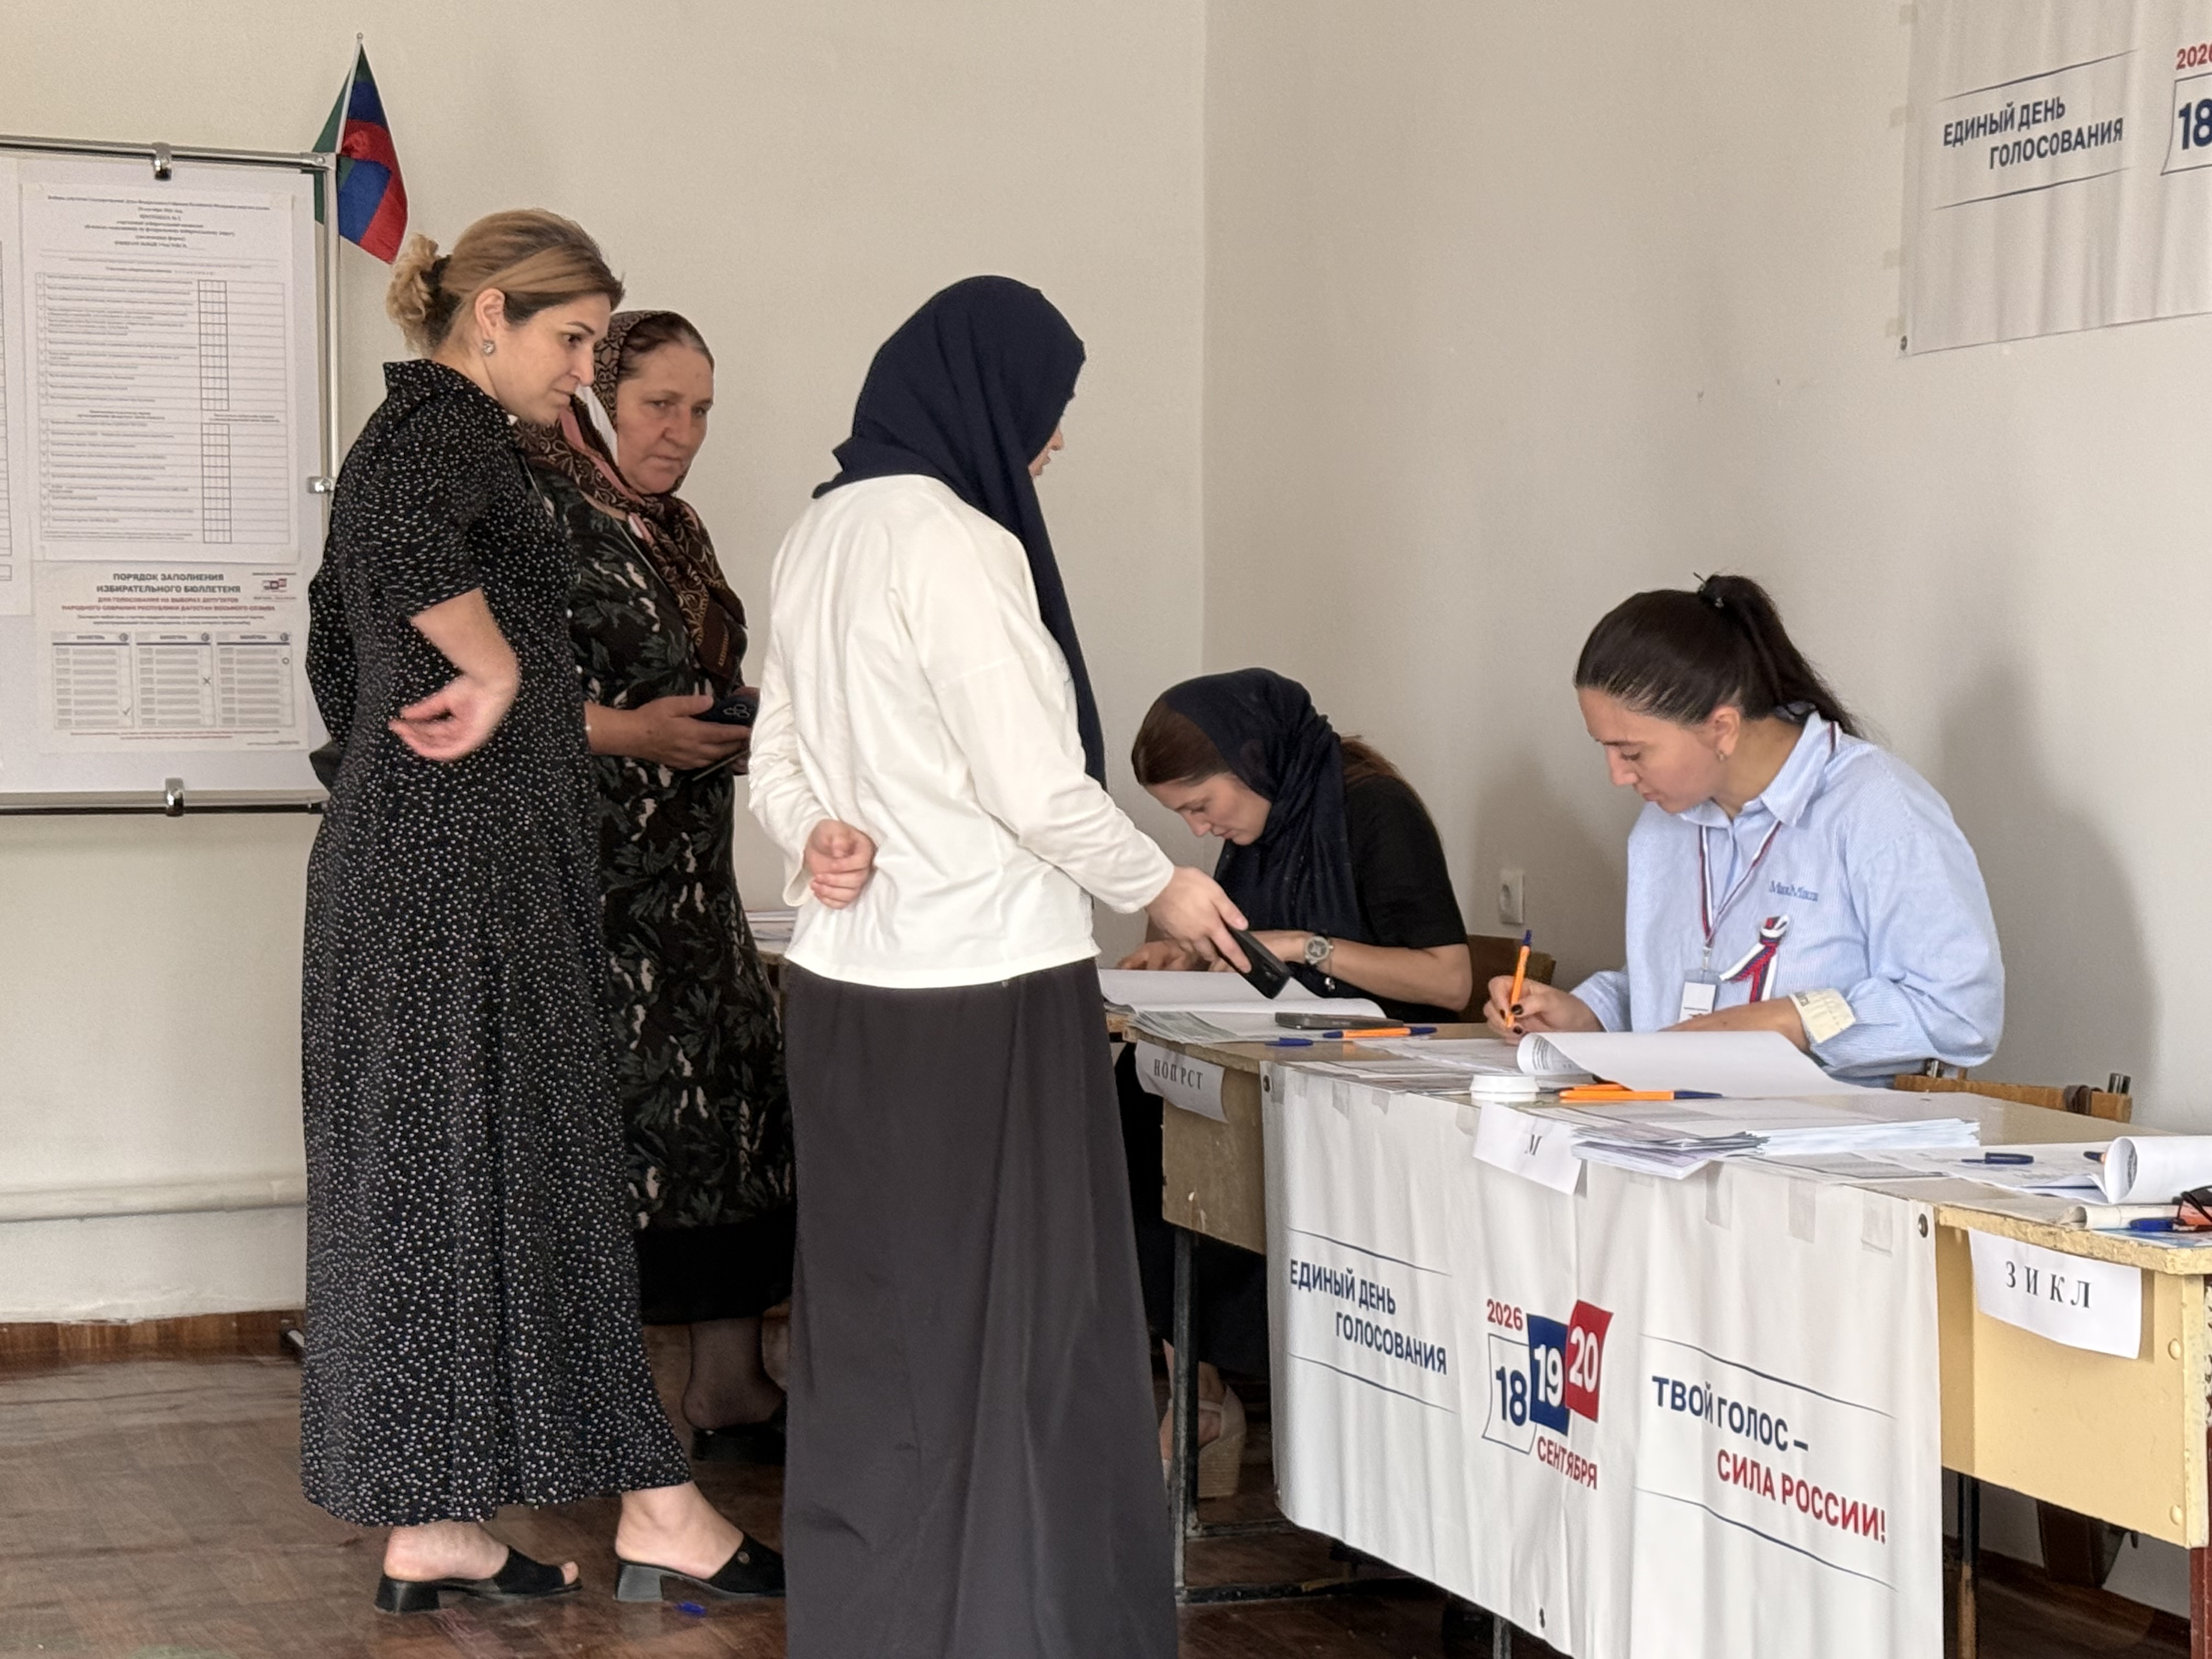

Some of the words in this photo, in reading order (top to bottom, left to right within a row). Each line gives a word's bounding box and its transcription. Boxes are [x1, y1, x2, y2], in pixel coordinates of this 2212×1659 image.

[1944, 103, 2015, 148] ЕДИНЫЙ
[2018, 97, 2066, 132] ДЕНЬ
[1989, 117, 2124, 169] ГОЛОСОВАНИЯ
[2179, 99, 2212, 150] 18
[113, 573, 158, 582] ПОРЯДОК
[161, 573, 224, 582] ЗАПОЛНЕНИЯ
[1290, 1260, 1356, 1302] ЕДИНЫЙ
[1358, 1282, 1396, 1315] ДЕНЬ
[1486, 1299, 1523, 1331] 2026
[1336, 1312, 1447, 1375] ГОЛОСОВАНИЯ
[1496, 1366, 1527, 1426] 18
[1534, 1344, 1563, 1407] 19
[1568, 1326, 1599, 1393] 20
[1652, 1376, 1714, 1424] ТВОЙ
[1718, 1396, 1788, 1452] ГОЛОС
[1537, 1436, 1597, 1490] СЕНТЯБРЯ
[1717, 1449, 1776, 1501] СИЛА
[1782, 1472, 1886, 1544] РОССИИ!
